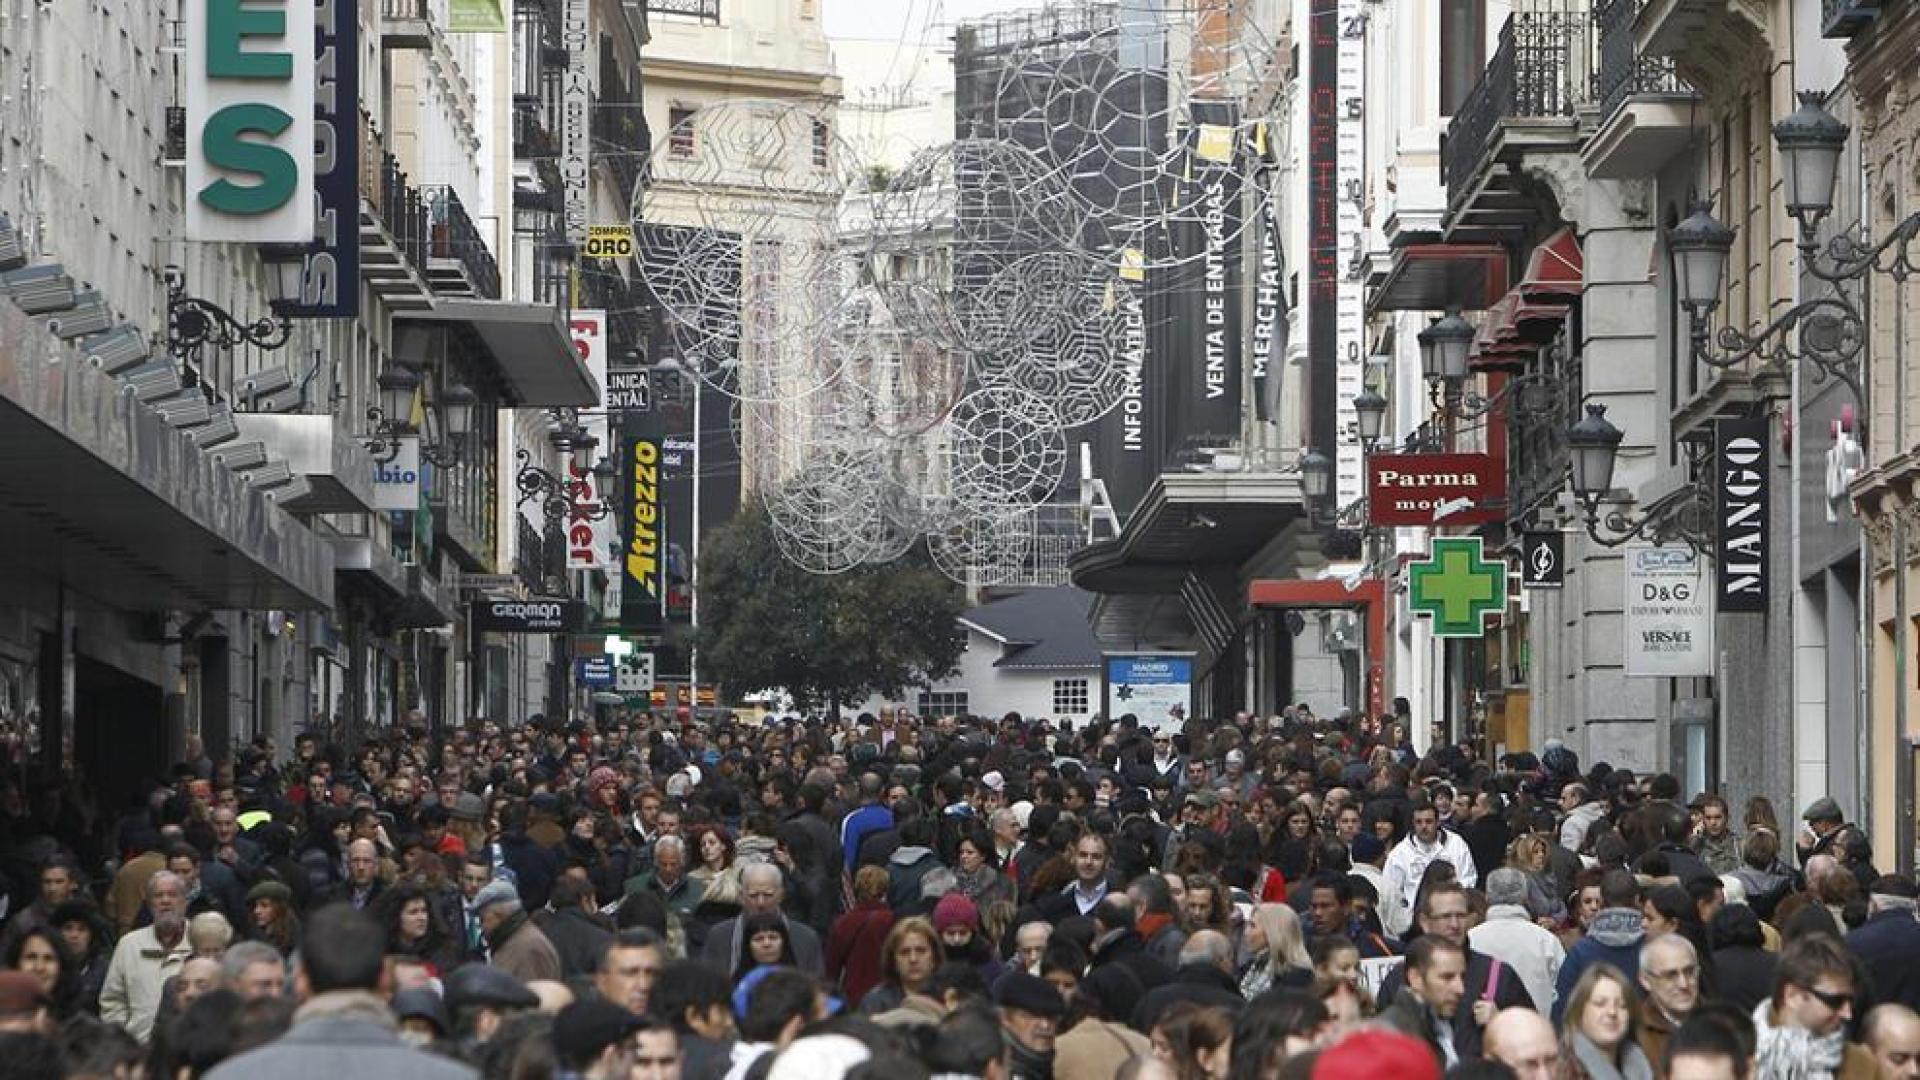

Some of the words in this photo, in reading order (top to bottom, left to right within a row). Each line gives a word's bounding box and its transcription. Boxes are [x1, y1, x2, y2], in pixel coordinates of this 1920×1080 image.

[588, 226, 632, 236] COMPRO
[1205, 179, 1226, 292] ENTRADAS
[587, 238, 632, 256] ORO
[1205, 297, 1226, 326] DE
[1205, 331, 1226, 399] VENTA
[1377, 470, 1479, 488] Parma
[626, 440, 659, 599] Atrezzo
[1725, 437, 1762, 595] MANGO
[1642, 583, 1690, 602] D&G
